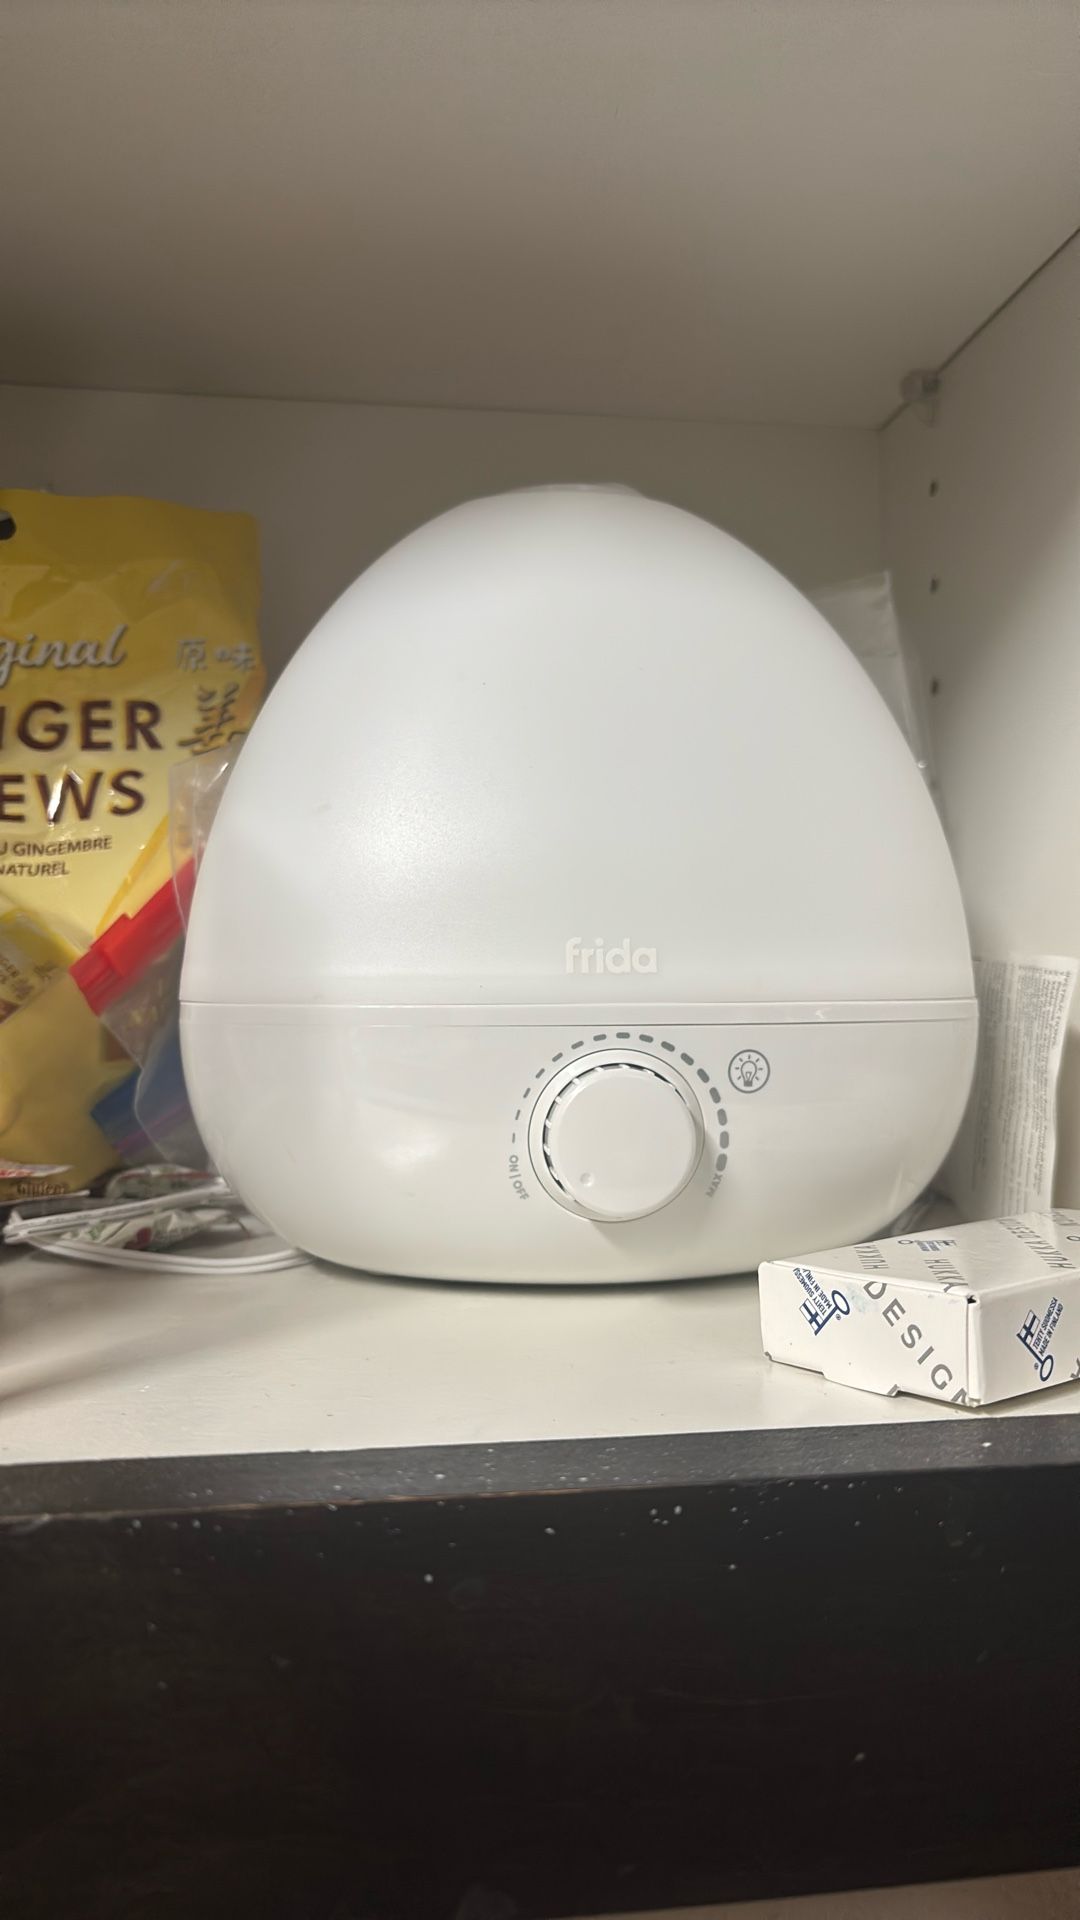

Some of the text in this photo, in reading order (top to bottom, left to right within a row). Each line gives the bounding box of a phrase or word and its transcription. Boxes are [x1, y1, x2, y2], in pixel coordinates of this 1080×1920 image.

[0, 700, 162, 751] GER
[13, 835, 113, 857] GINGEMBRE
[565, 937, 658, 974] frida
[705, 1172, 723, 1198] MAX
[923, 1258, 969, 1293] HUKKA
[818, 1290, 833, 1310] MADE
[1038, 1340, 1050, 1357] MADE
[1049, 1303, 1064, 1332] FINLAND
